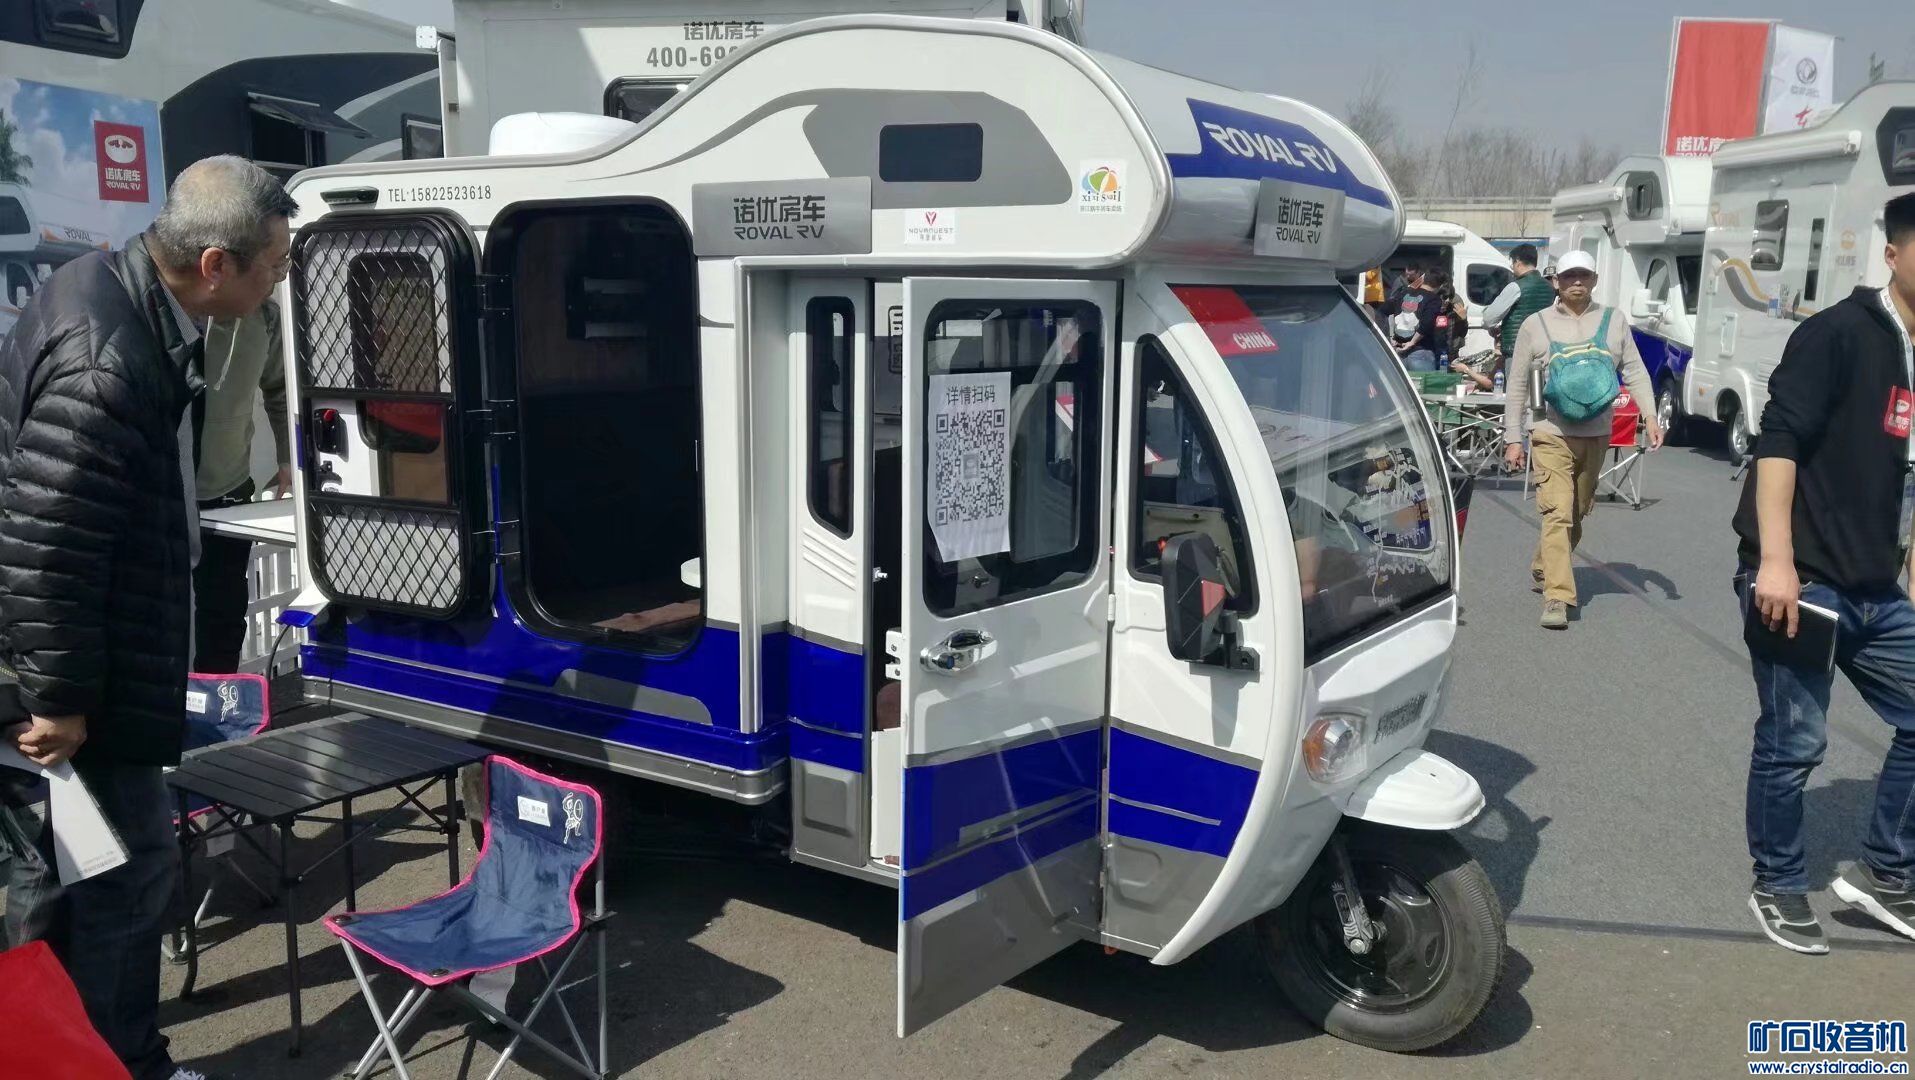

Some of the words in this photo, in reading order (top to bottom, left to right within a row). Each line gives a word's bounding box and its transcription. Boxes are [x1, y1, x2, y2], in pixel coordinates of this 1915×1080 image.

[683, 21, 764, 40] 诺优房车
[1676, 136, 1735, 152] 诺优房
[1294, 141, 1337, 173] RV
[105, 167, 141, 182] 诺优房车
[130, 182, 141, 190] RV
[733, 195, 826, 224] 诺优房车
[1278, 197, 1325, 228] 诺优房车
[797, 224, 825, 239] RV
[1307, 230, 1321, 244] RV
[1232, 331, 1276, 350] CHINA
[946, 384, 995, 405] 详情扫码
